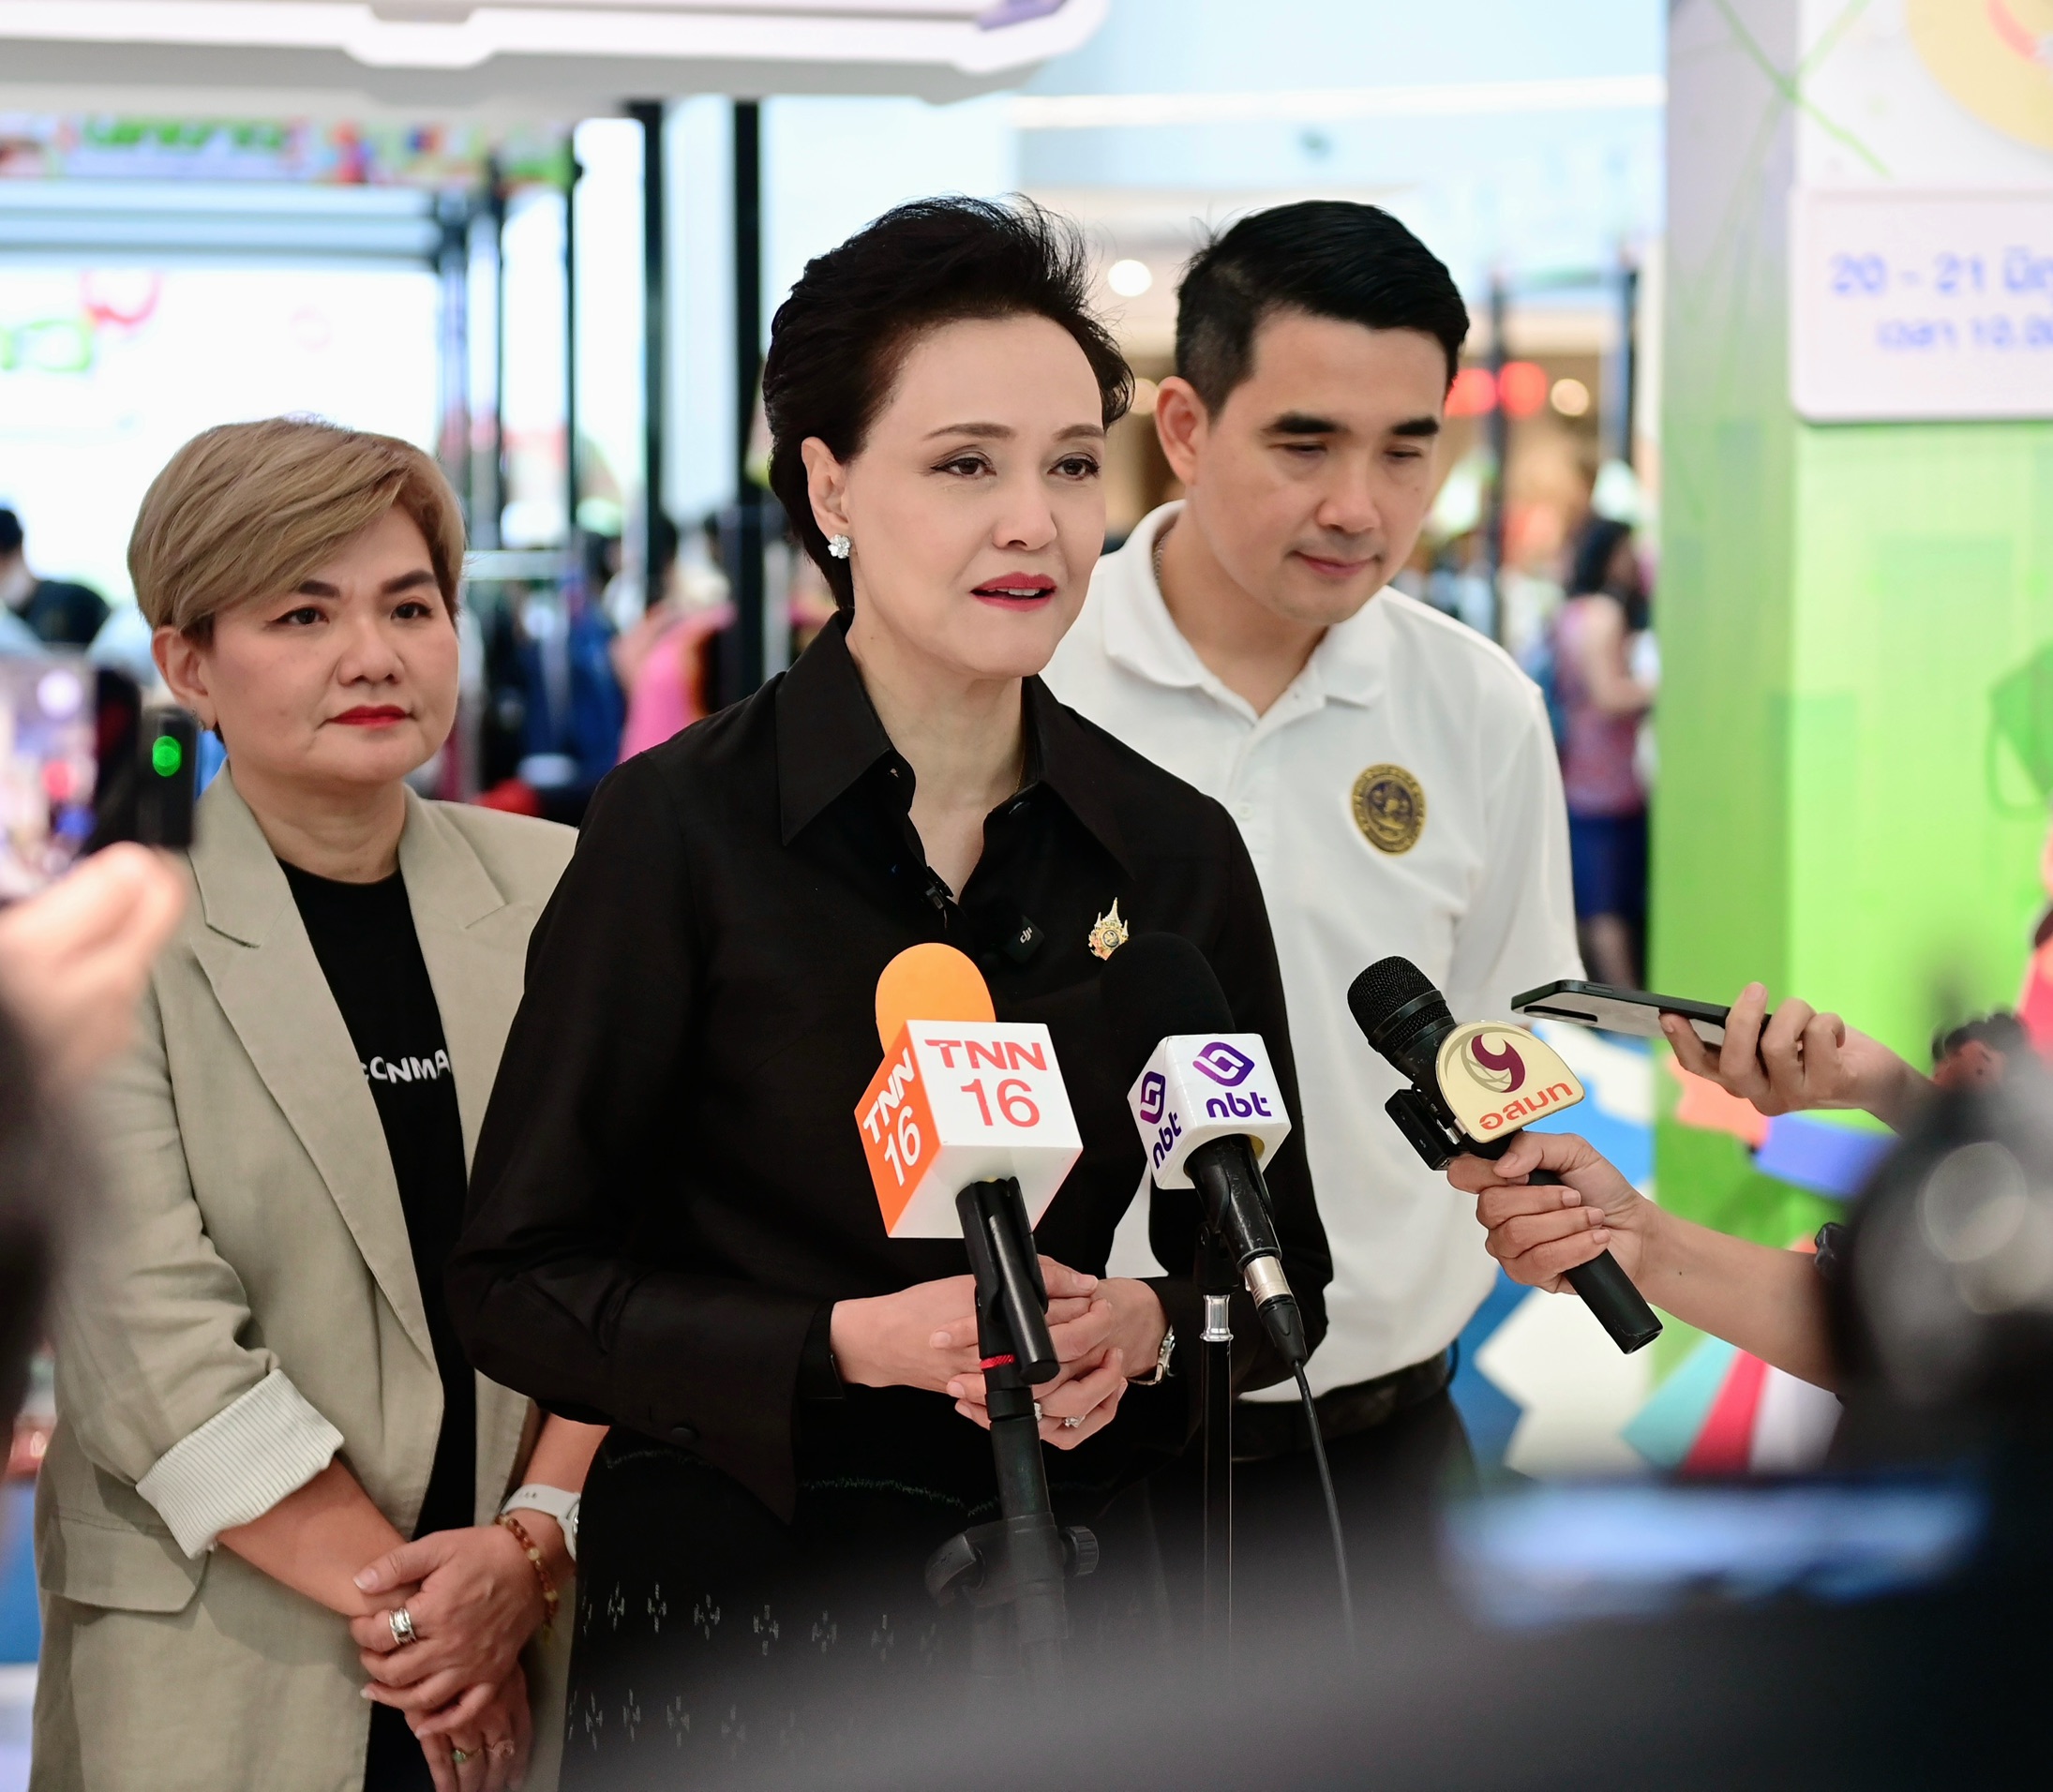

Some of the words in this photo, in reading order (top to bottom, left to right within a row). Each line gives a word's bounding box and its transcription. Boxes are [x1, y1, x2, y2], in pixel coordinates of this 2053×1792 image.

[924, 1038, 1047, 1071] TNN
[862, 1047, 915, 1144] TNN
[960, 1078, 1041, 1127] 16
[1206, 1092, 1272, 1118] nbt
[1478, 1082, 1574, 1130] อสมท
[884, 1105, 921, 1187] 16
[1152, 1112, 1182, 1170] nbt
